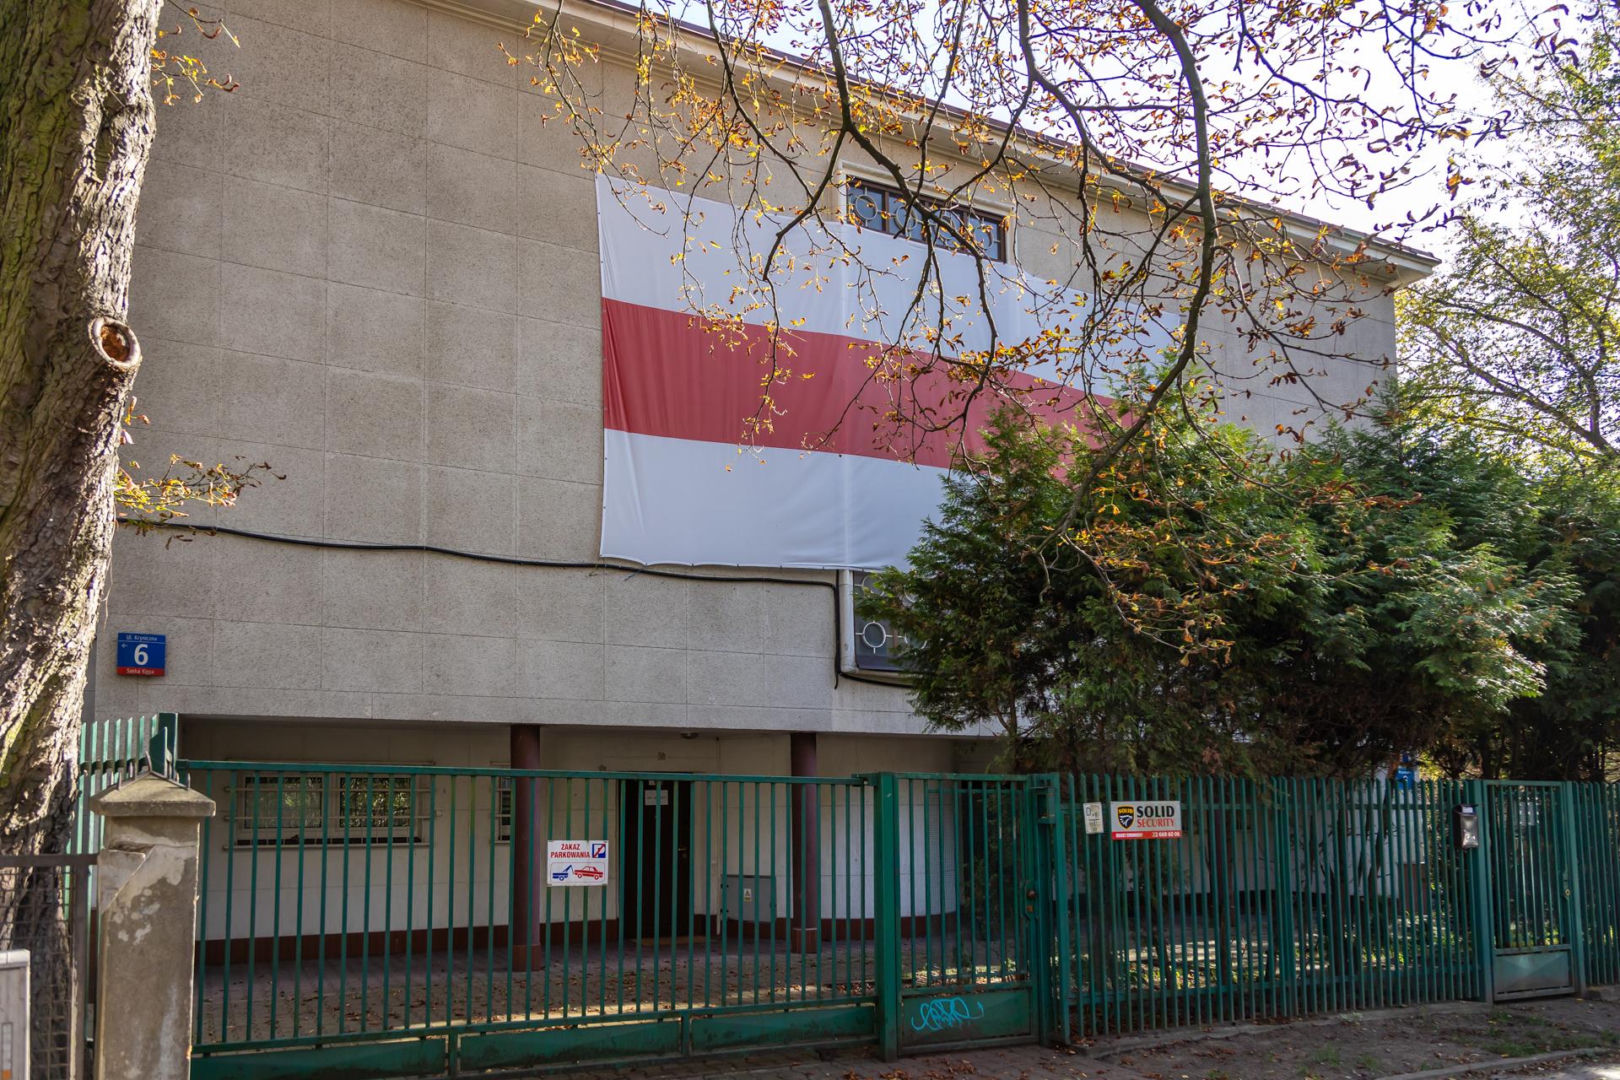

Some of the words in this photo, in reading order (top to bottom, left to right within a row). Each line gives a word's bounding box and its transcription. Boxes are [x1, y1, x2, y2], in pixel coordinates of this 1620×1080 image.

[134, 643, 149, 665] 6
[1136, 805, 1175, 818] SOLID
[1137, 818, 1175, 828] SECURITY
[560, 843, 581, 851] ZAKAZ
[550, 851, 590, 859] PARKOWANIA
